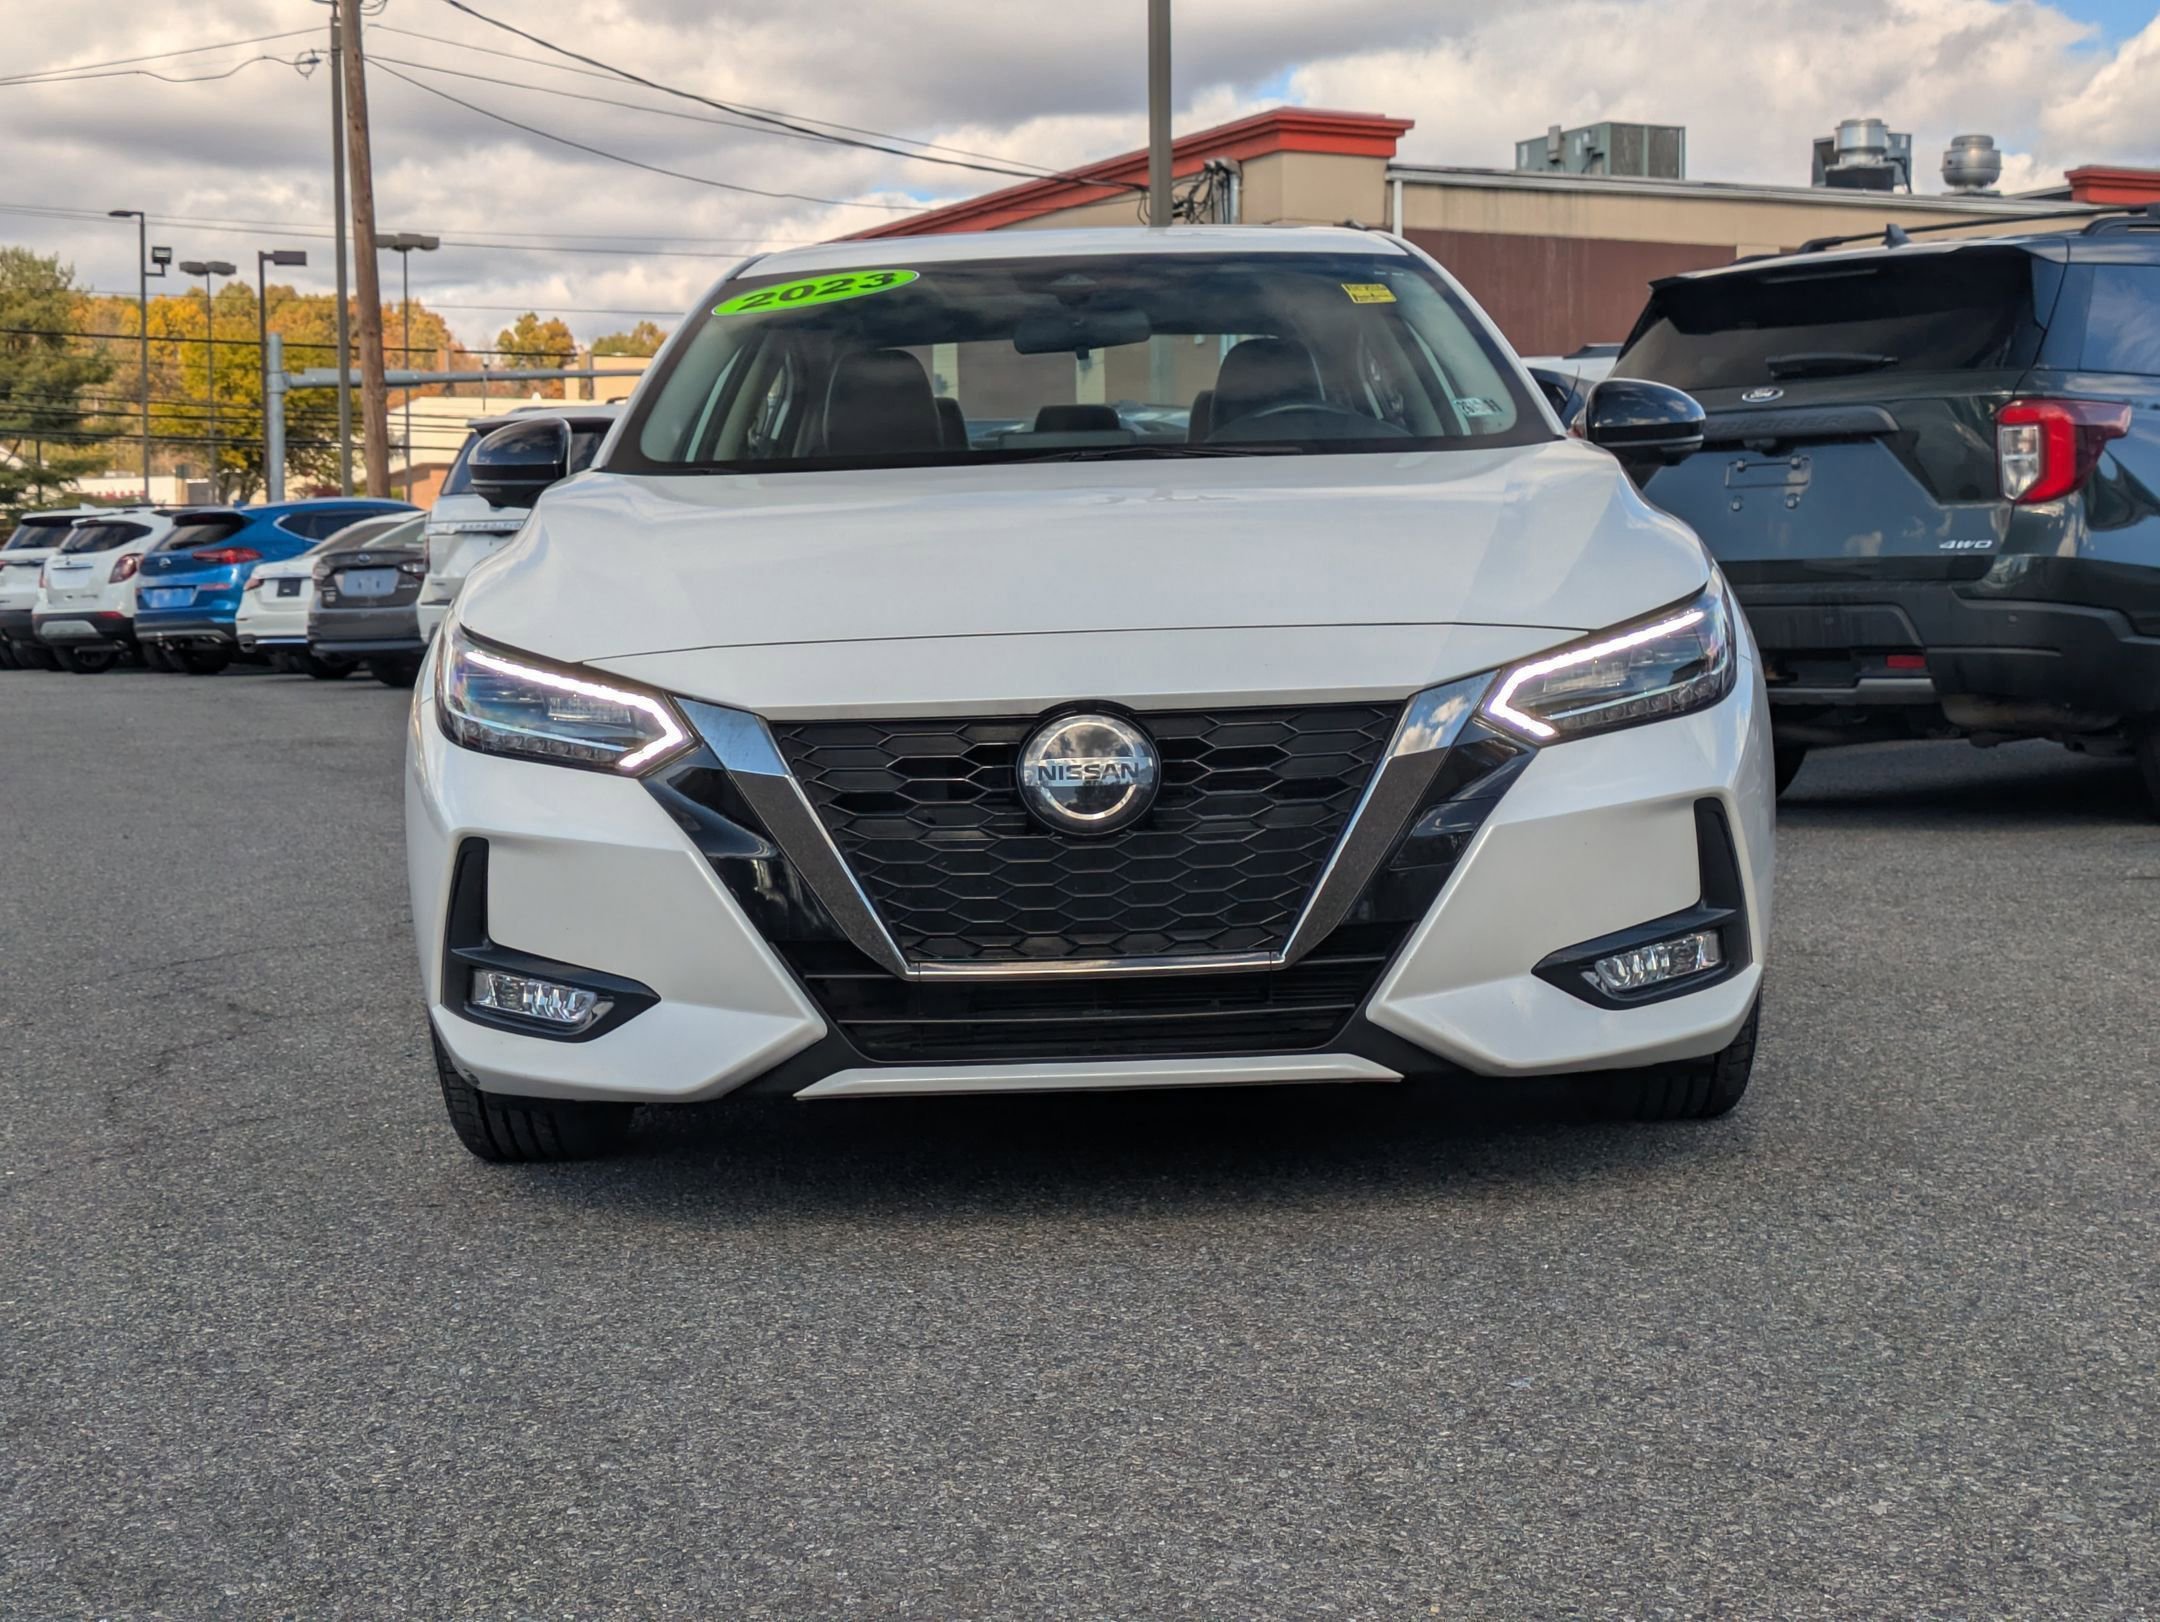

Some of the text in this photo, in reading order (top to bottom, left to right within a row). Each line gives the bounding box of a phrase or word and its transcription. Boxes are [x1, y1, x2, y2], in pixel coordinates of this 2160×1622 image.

[737, 272, 896, 312] 2023
[1938, 539, 1993, 549] 4WD
[1037, 762, 1139, 781] NISSAN
